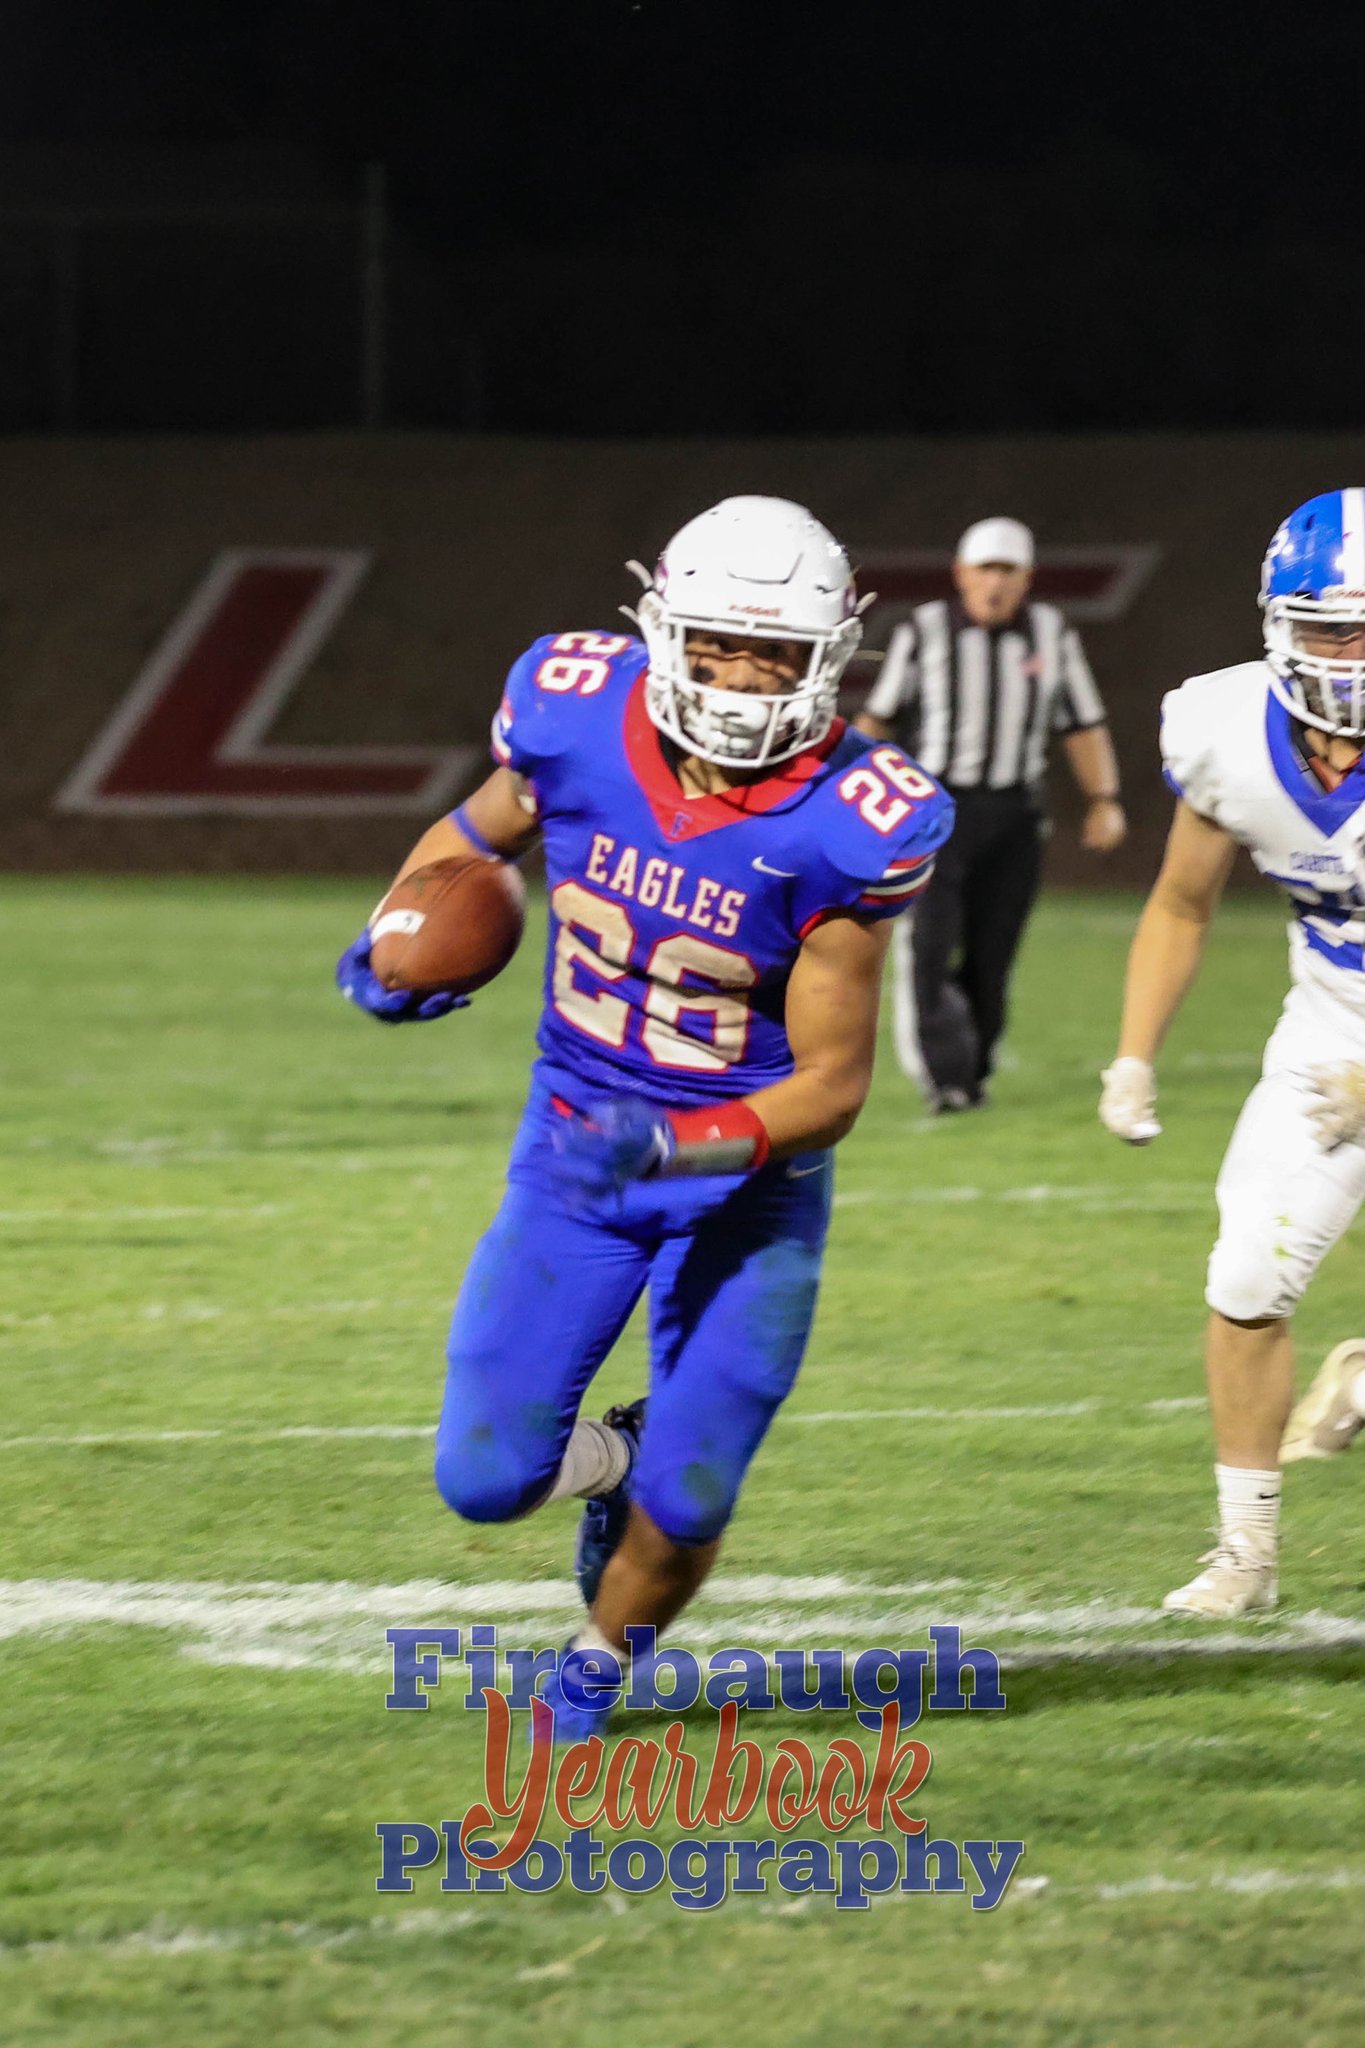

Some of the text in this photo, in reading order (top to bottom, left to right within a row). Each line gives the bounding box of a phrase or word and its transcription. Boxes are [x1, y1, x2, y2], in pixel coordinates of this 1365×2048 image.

[535, 631, 631, 696] 26
[837, 746, 938, 838] 26
[585, 832, 747, 938] EAGLES
[552, 878, 759, 1074] 26
